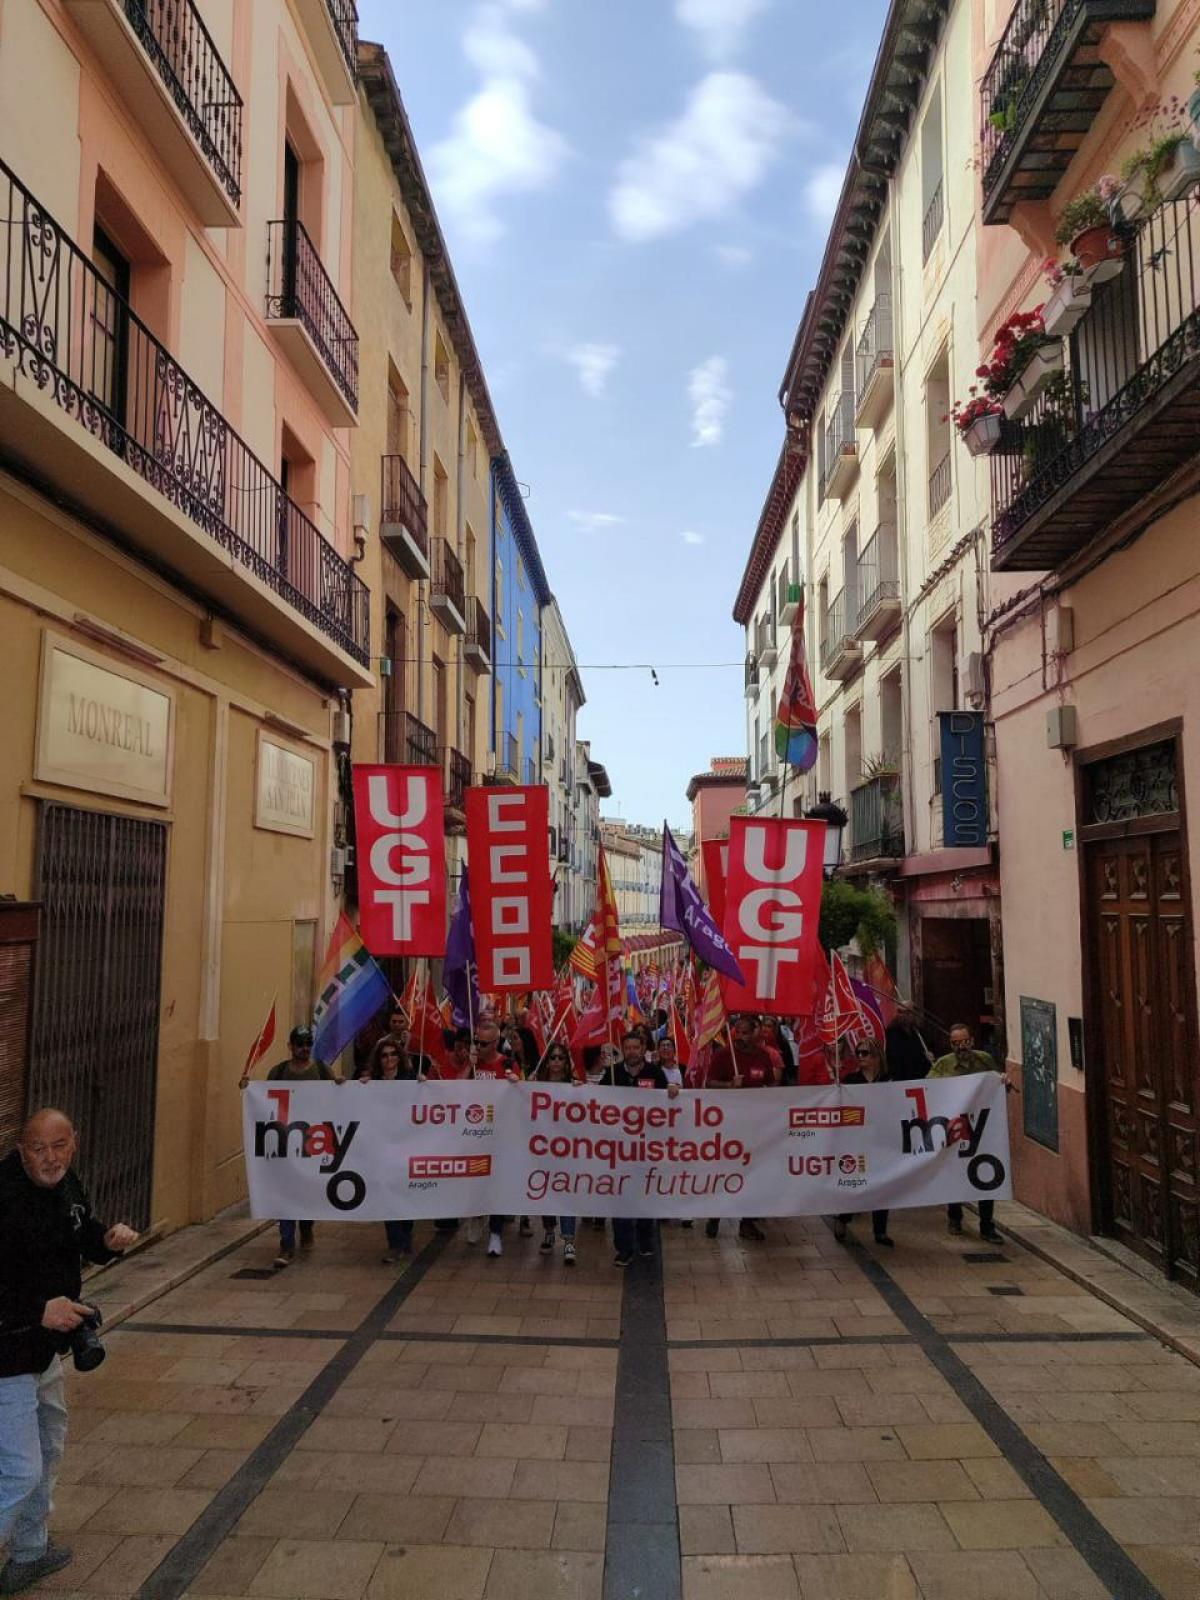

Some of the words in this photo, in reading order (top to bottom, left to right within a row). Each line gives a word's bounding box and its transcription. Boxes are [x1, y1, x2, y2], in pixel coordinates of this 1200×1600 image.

[66, 692, 153, 757] MONREAL
[950, 713, 979, 844] DISCOS
[367, 775, 431, 941] UGT
[487, 793, 531, 986] CCOO
[738, 826, 809, 1000] UGT
[411, 1104, 461, 1125] UGT
[530, 1091, 682, 1135] Proteger
[694, 1098, 724, 1127] lo
[793, 1111, 840, 1124] CCOO
[462, 1127, 493, 1138] Aragón
[788, 1130, 816, 1139] Aragón
[413, 1160, 467, 1174] CCOO
[528, 1133, 751, 1169] conquistado,
[788, 1155, 835, 1176] UGT
[526, 1169, 631, 1200] ganar
[644, 1167, 744, 1196] futuro
